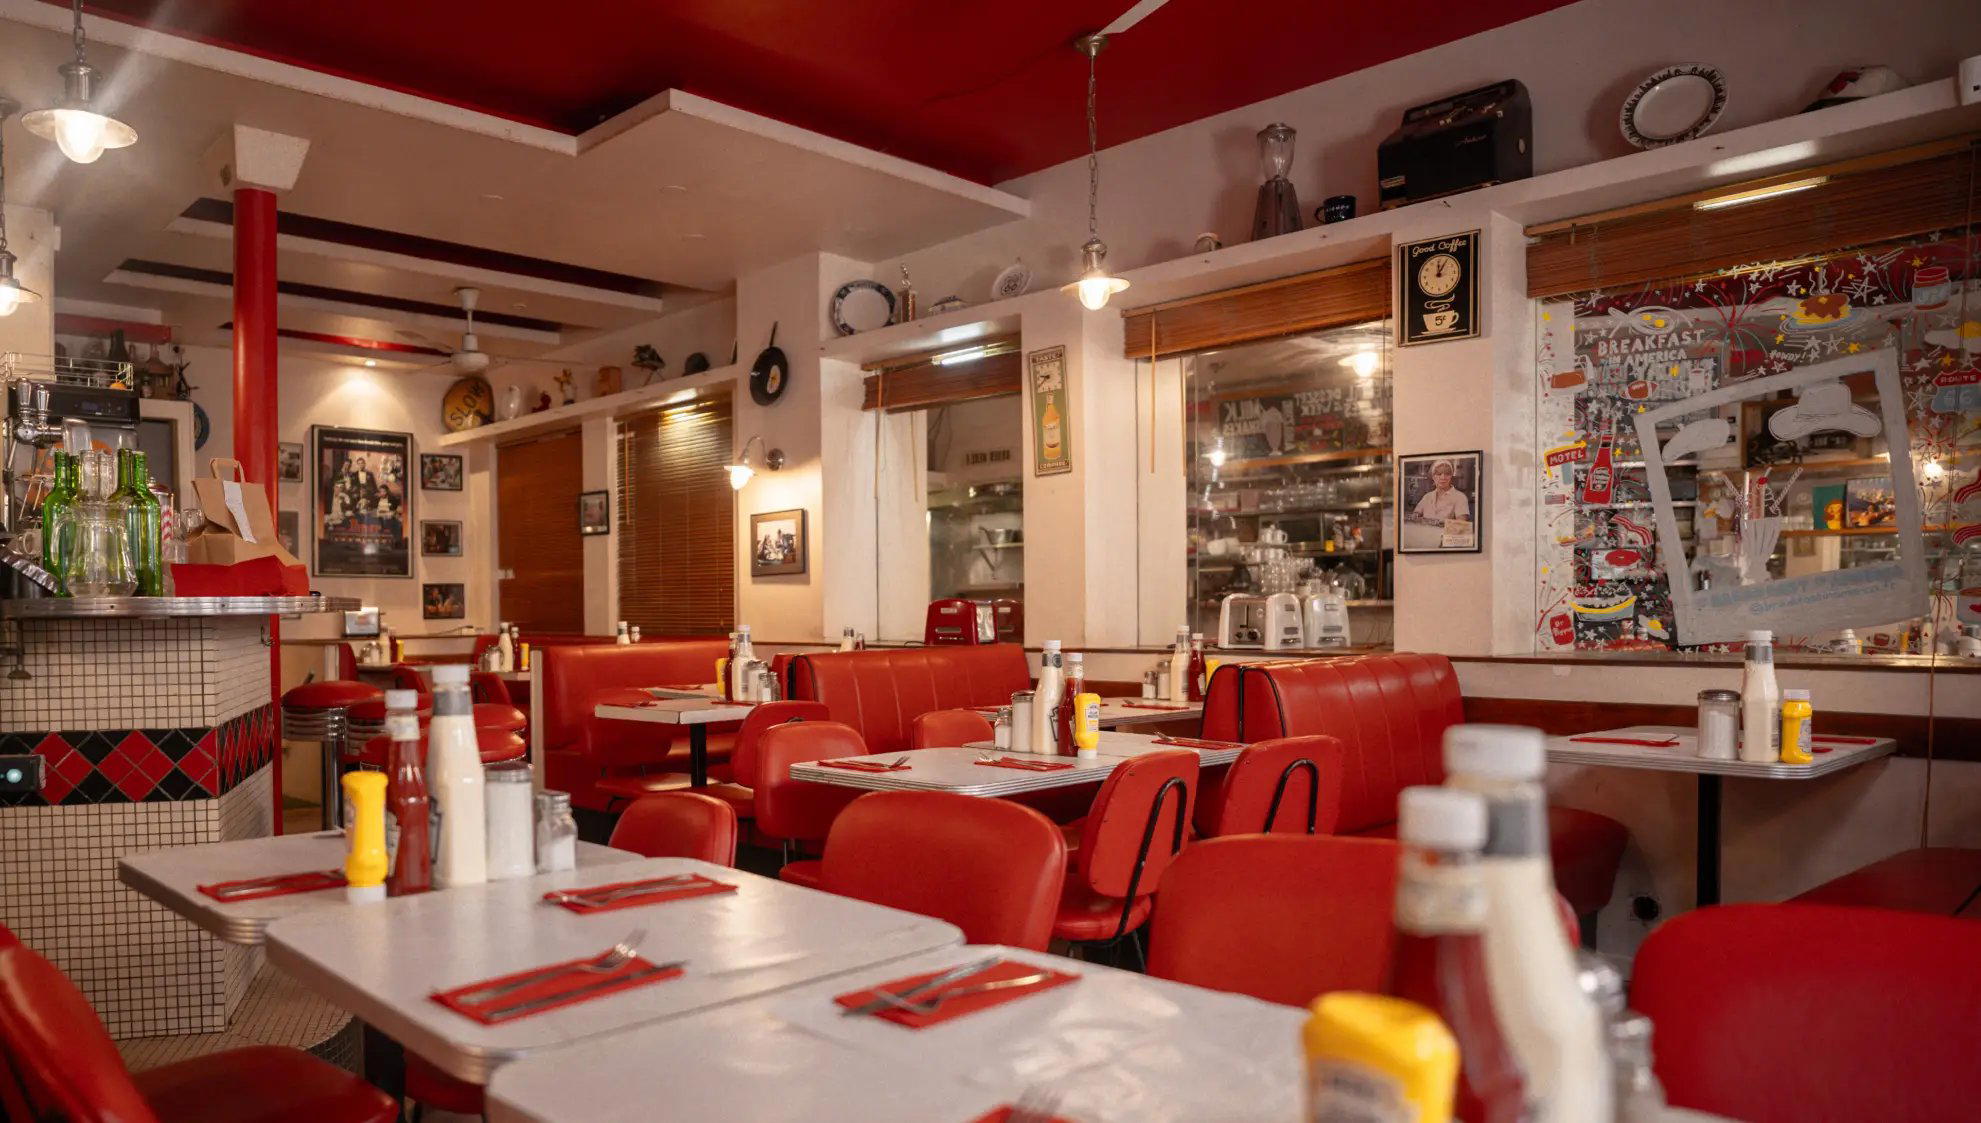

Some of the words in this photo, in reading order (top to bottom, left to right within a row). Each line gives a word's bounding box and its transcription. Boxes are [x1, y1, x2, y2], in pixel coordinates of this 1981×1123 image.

[1412, 243, 1435, 258] Good
[1438, 238, 1467, 253] Coffee
[1597, 328, 1705, 357] BREAKFAST
[1624, 348, 1687, 368] AMERICA
[450, 378, 486, 427] SLOW
[1549, 449, 1584, 466] MOTEL
